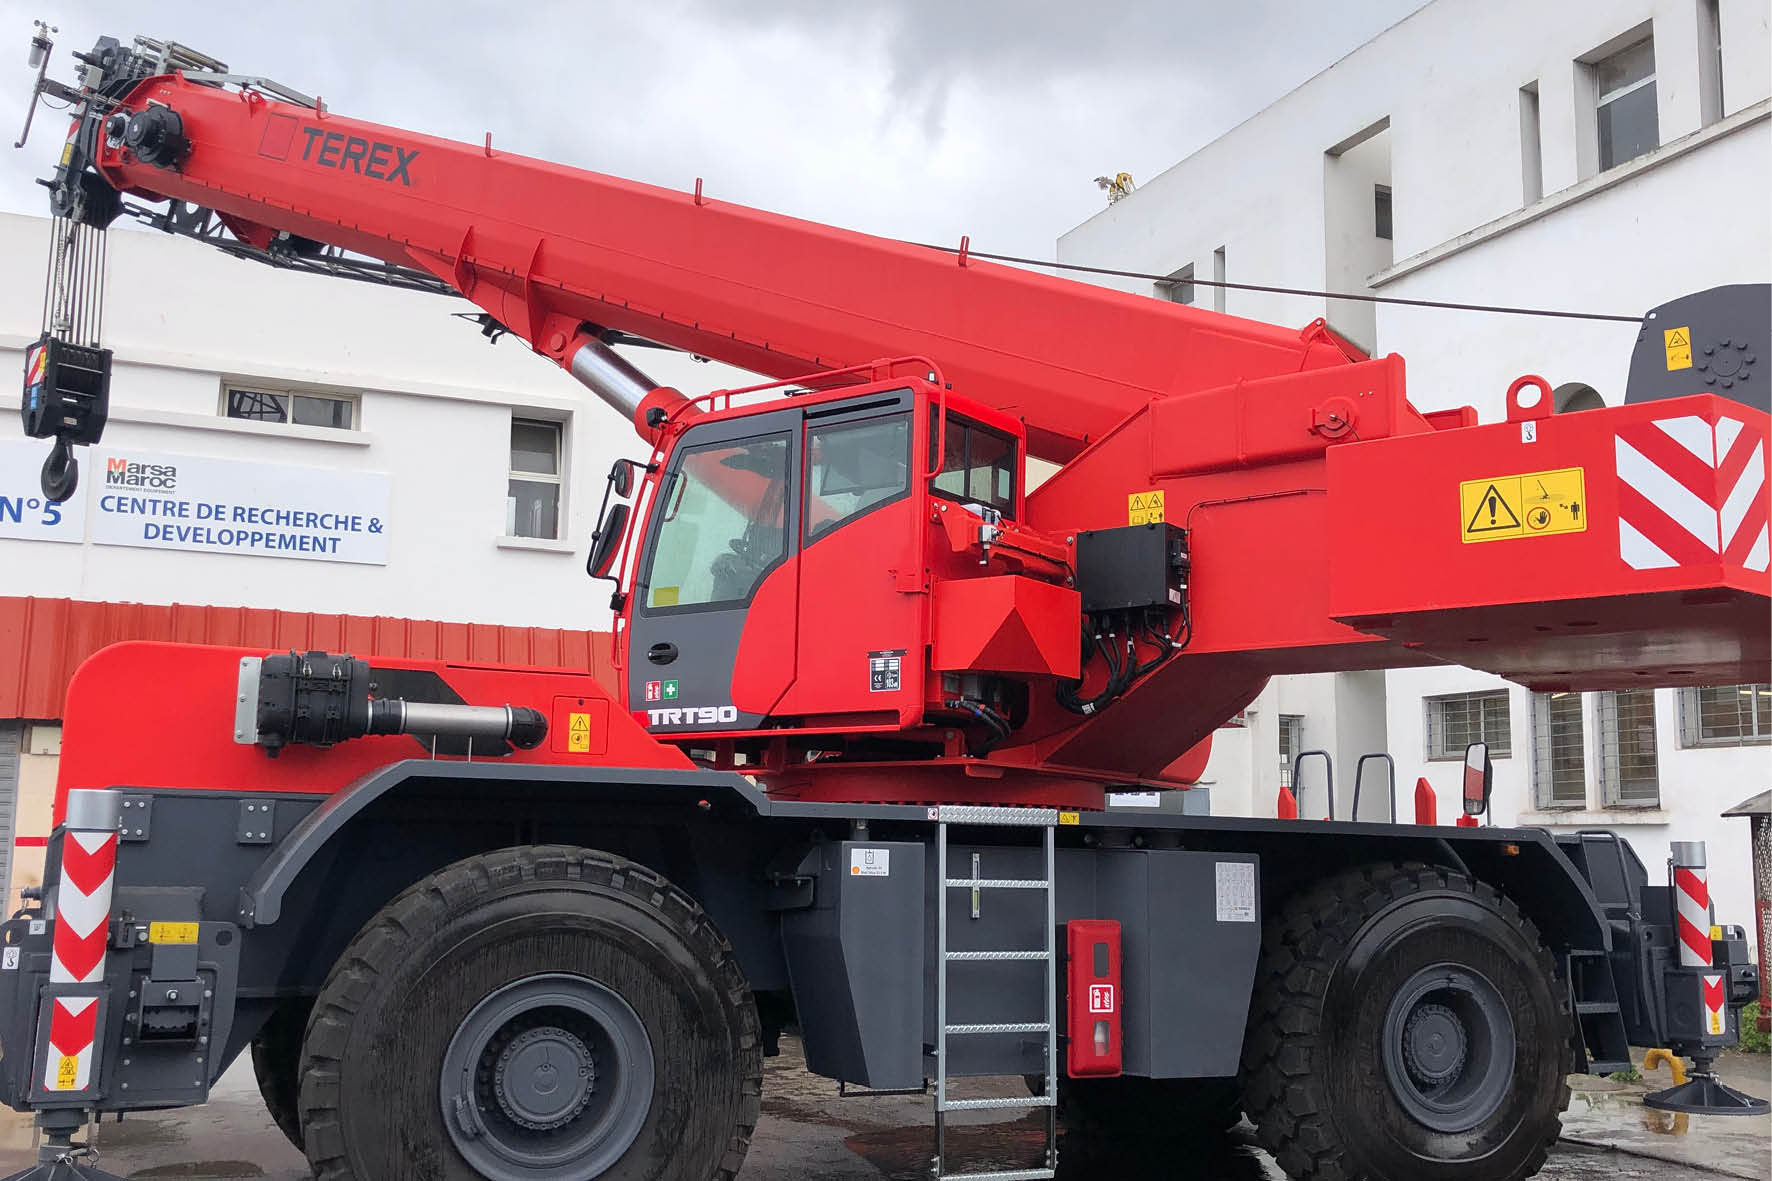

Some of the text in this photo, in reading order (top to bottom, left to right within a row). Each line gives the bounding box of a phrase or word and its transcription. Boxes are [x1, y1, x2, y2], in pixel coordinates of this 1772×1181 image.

[302, 127, 420, 186] TEREX
[106, 470, 177, 489] Maroc
[107, 457, 177, 477] Marsa
[100, 495, 384, 534] CENTRE DE RECHERCHE &
[143, 523, 341, 554] DEVELOPPEMENT
[648, 706, 738, 726] TRT90
